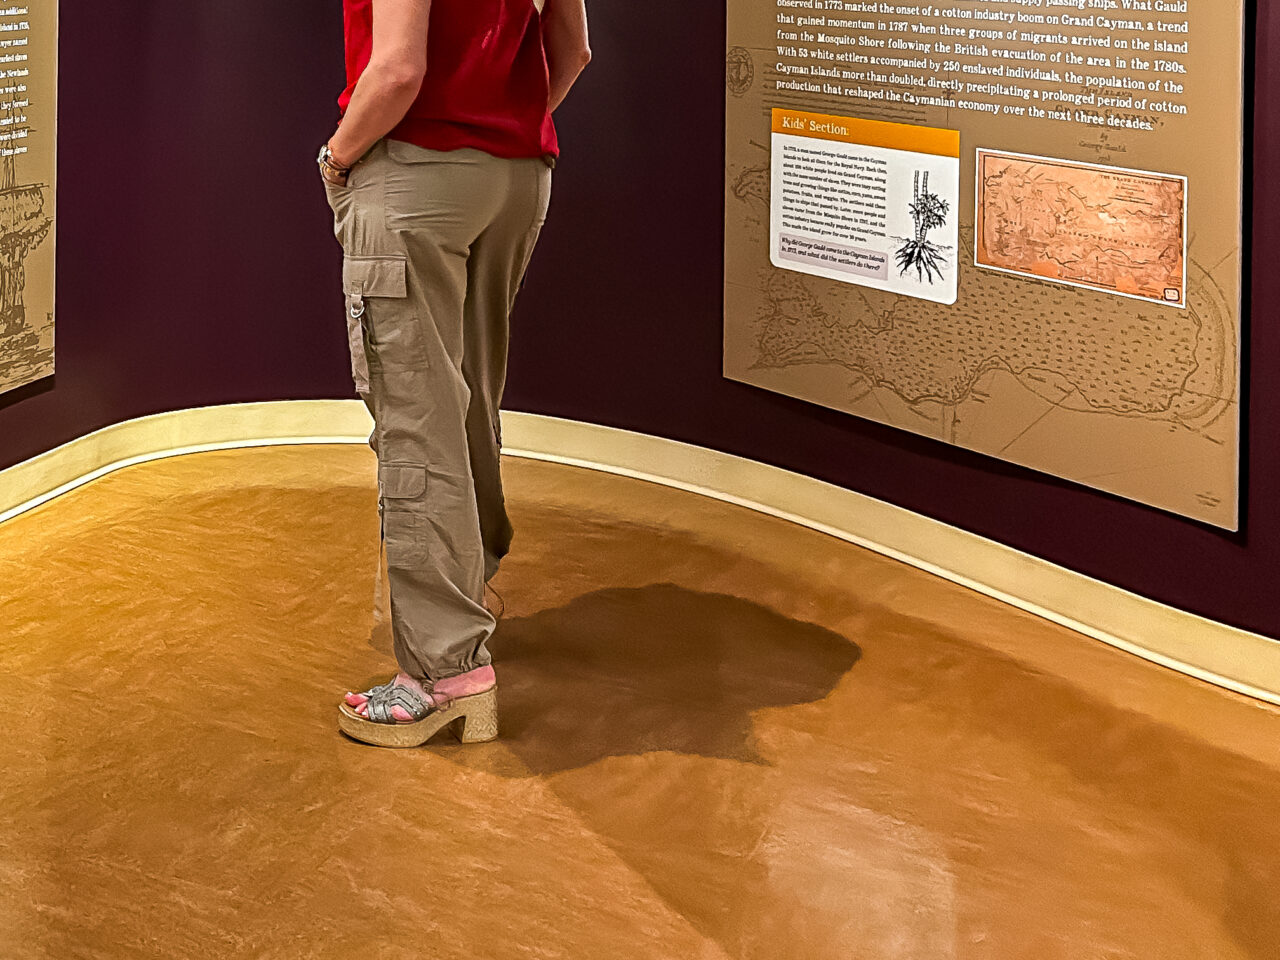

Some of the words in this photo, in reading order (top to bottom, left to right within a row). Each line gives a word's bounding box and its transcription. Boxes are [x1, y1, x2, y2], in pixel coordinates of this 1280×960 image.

[776, 81, 821, 96] production
[823, 84, 843, 96] that
[844, 86, 885, 103] reshaped
[886, 90, 901, 102] the
[903, 93, 955, 108] Caymanian
[958, 100, 1000, 114] economy
[1003, 106, 1025, 115] over
[1028, 106, 1045, 117] the
[1048, 110, 1071, 121] next
[1075, 111, 1104, 124] three
[1107, 114, 1154, 130] decades.
[809, 121, 849, 135] Section:
